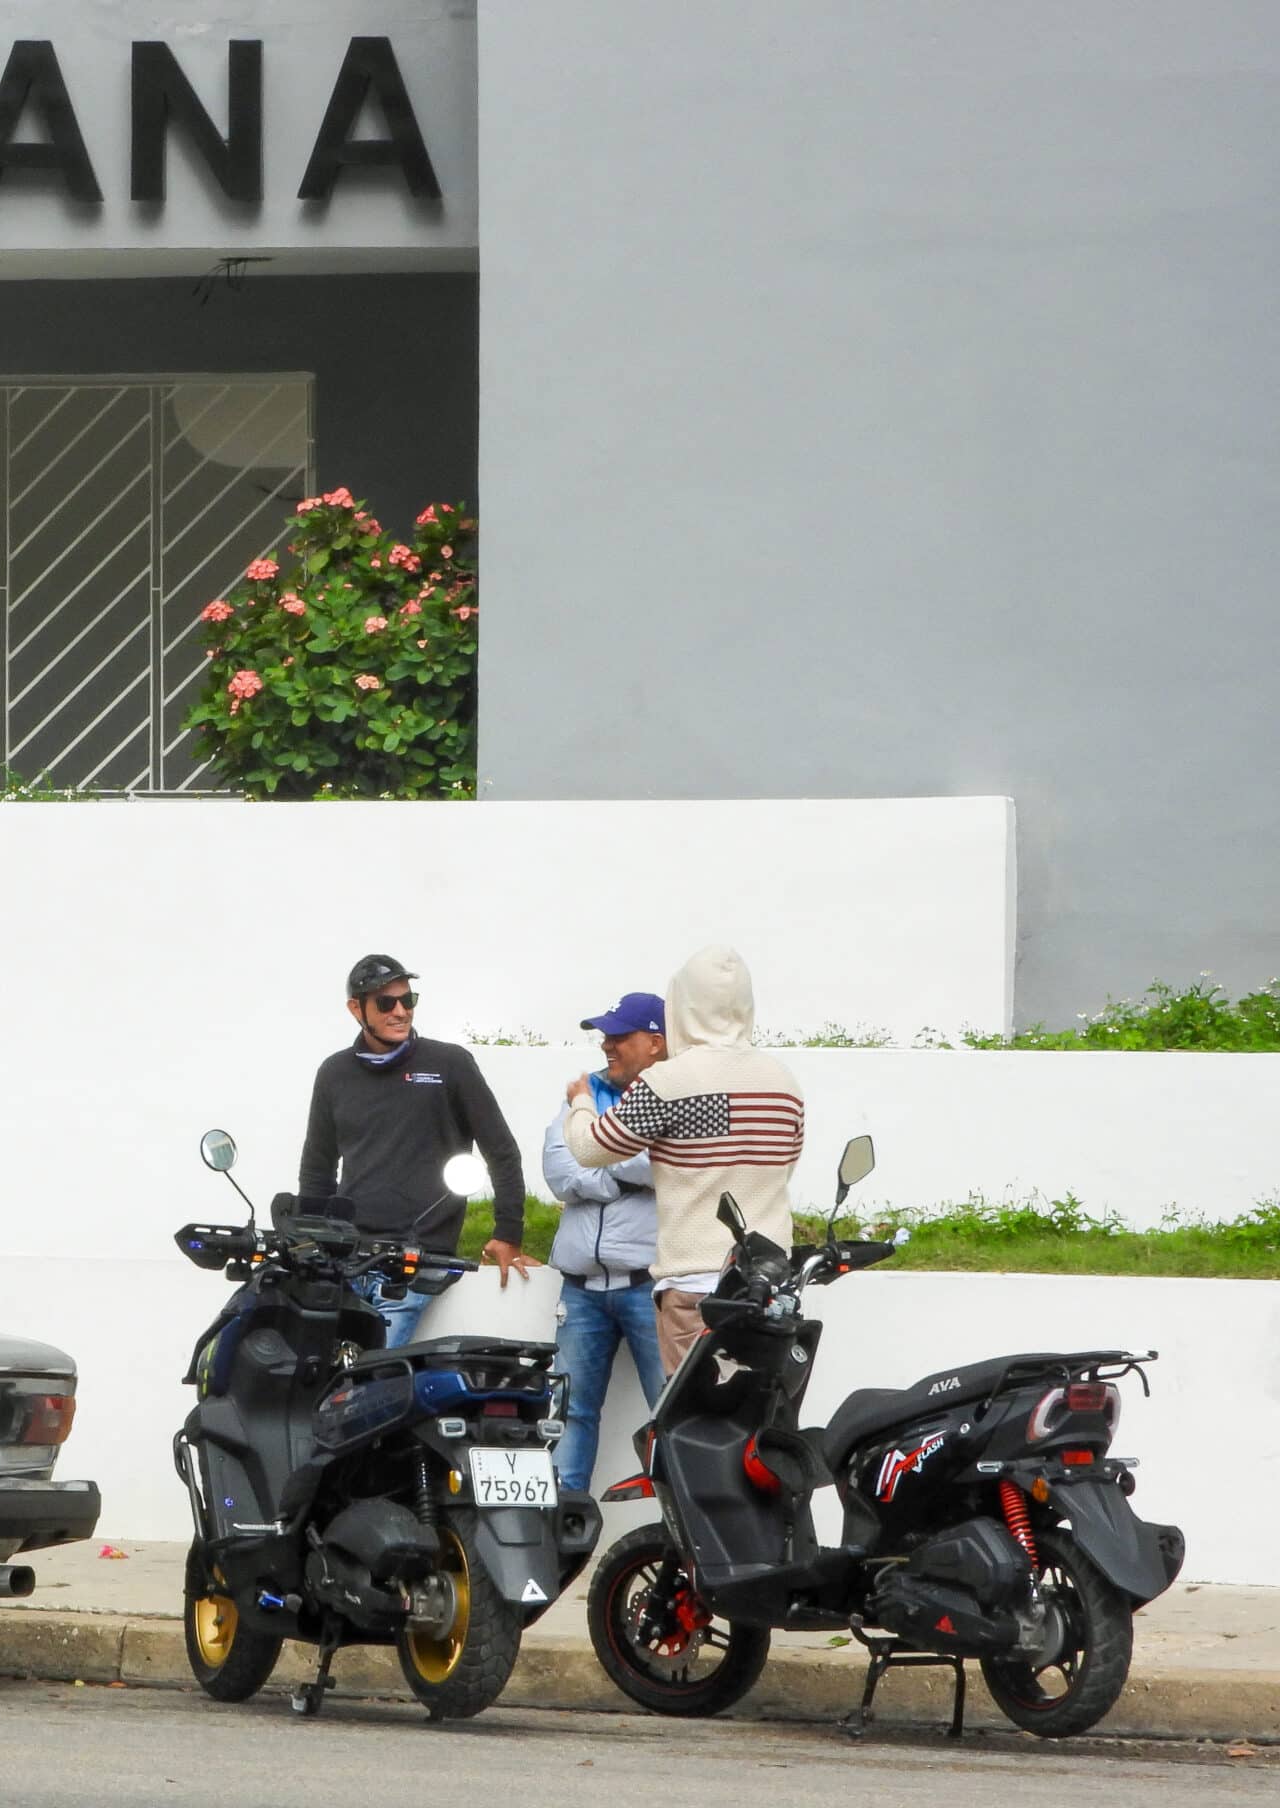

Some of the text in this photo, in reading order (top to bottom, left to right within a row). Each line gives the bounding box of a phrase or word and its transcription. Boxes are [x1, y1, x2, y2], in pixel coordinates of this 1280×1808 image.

[928, 1376, 962, 1396] AVA
[505, 1453, 517, 1475] Y
[480, 1480, 549, 1502] 75967
